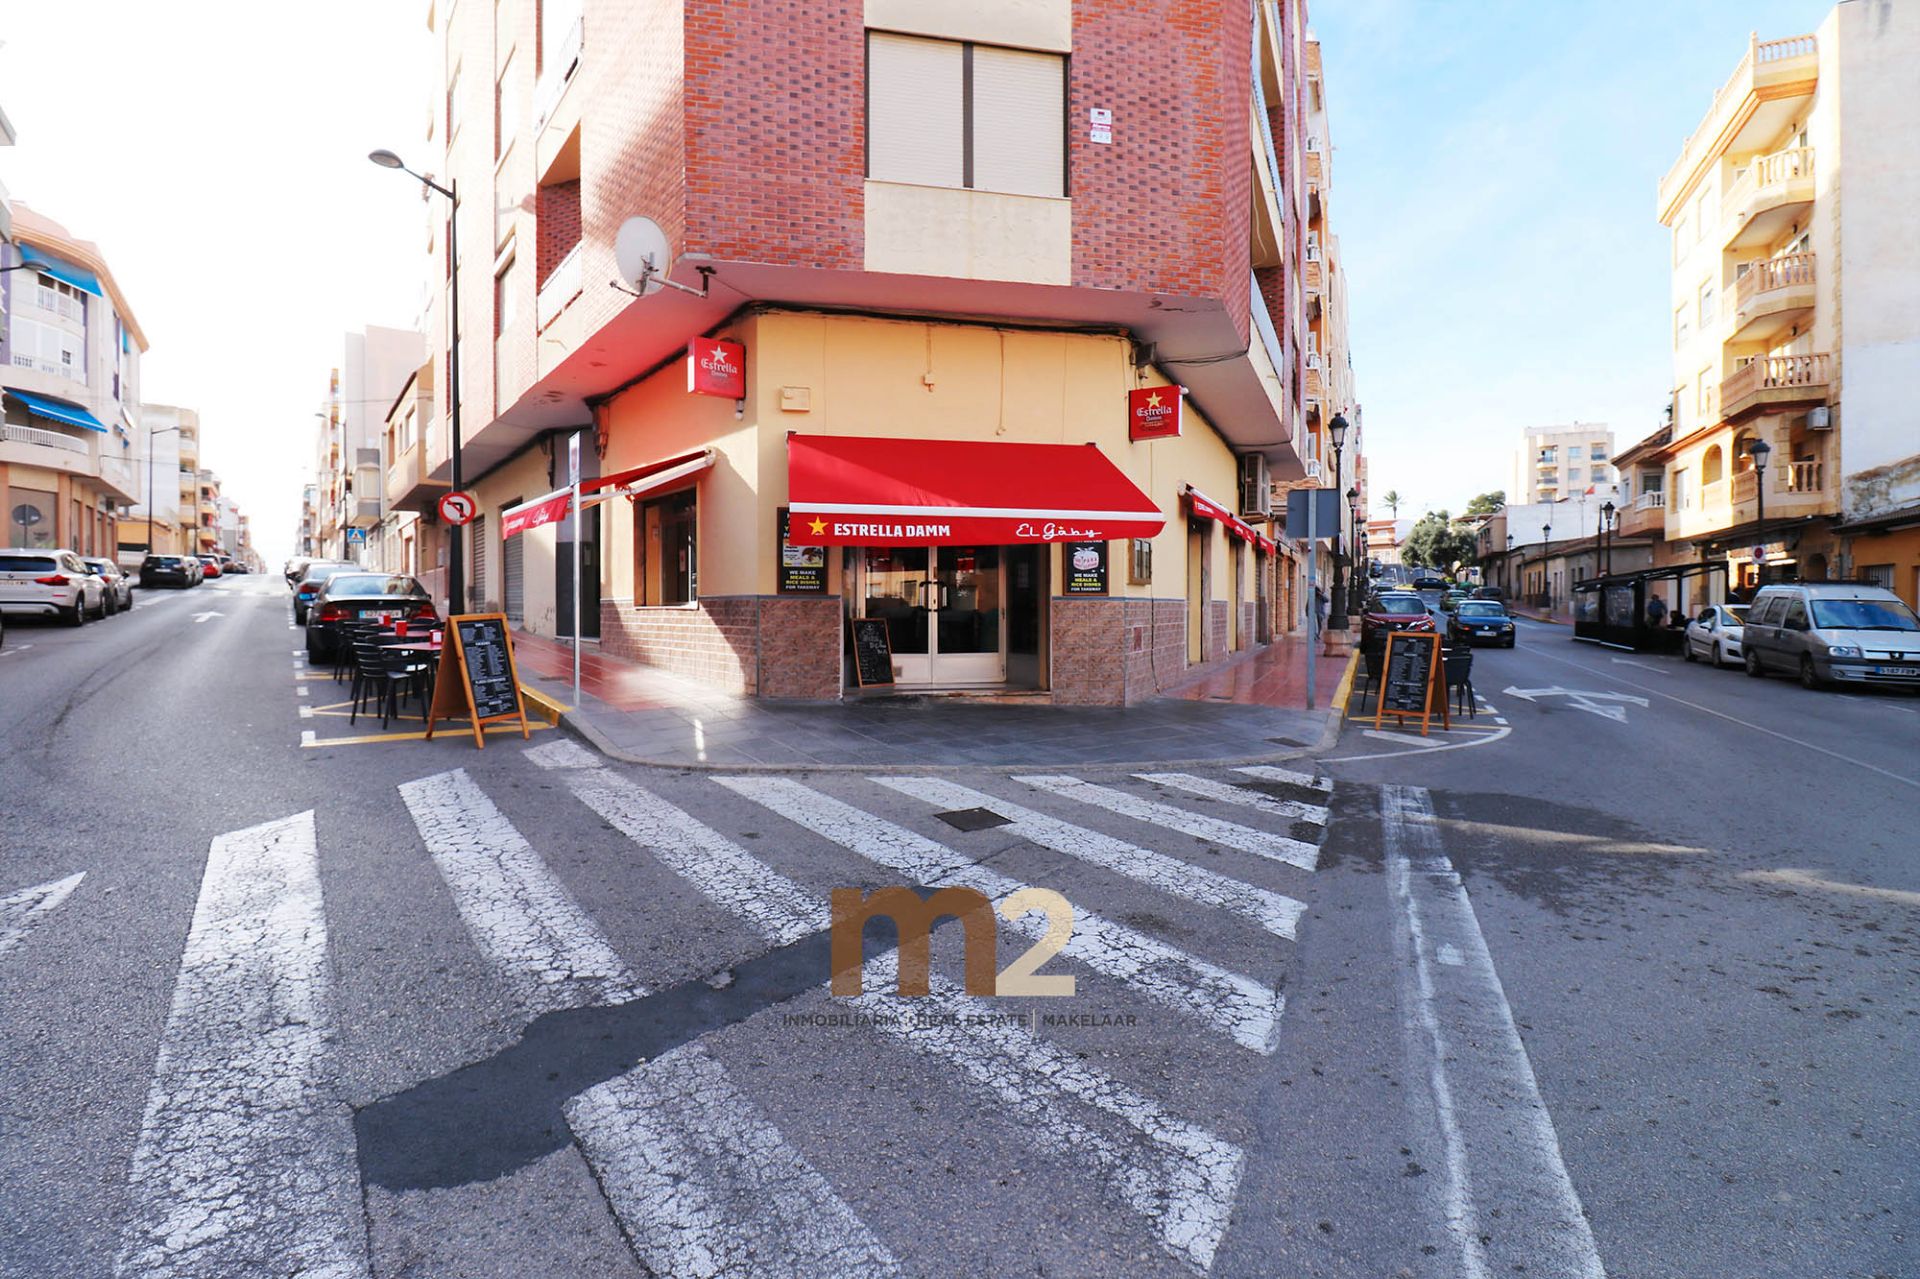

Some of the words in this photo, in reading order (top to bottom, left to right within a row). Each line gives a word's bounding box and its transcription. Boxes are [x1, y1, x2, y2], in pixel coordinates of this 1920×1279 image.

[700, 358, 738, 374] Estrella
[1136, 405, 1172, 417] Estrella
[834, 523, 903, 537] ESTRELLA
[906, 525, 950, 537] DAMM
